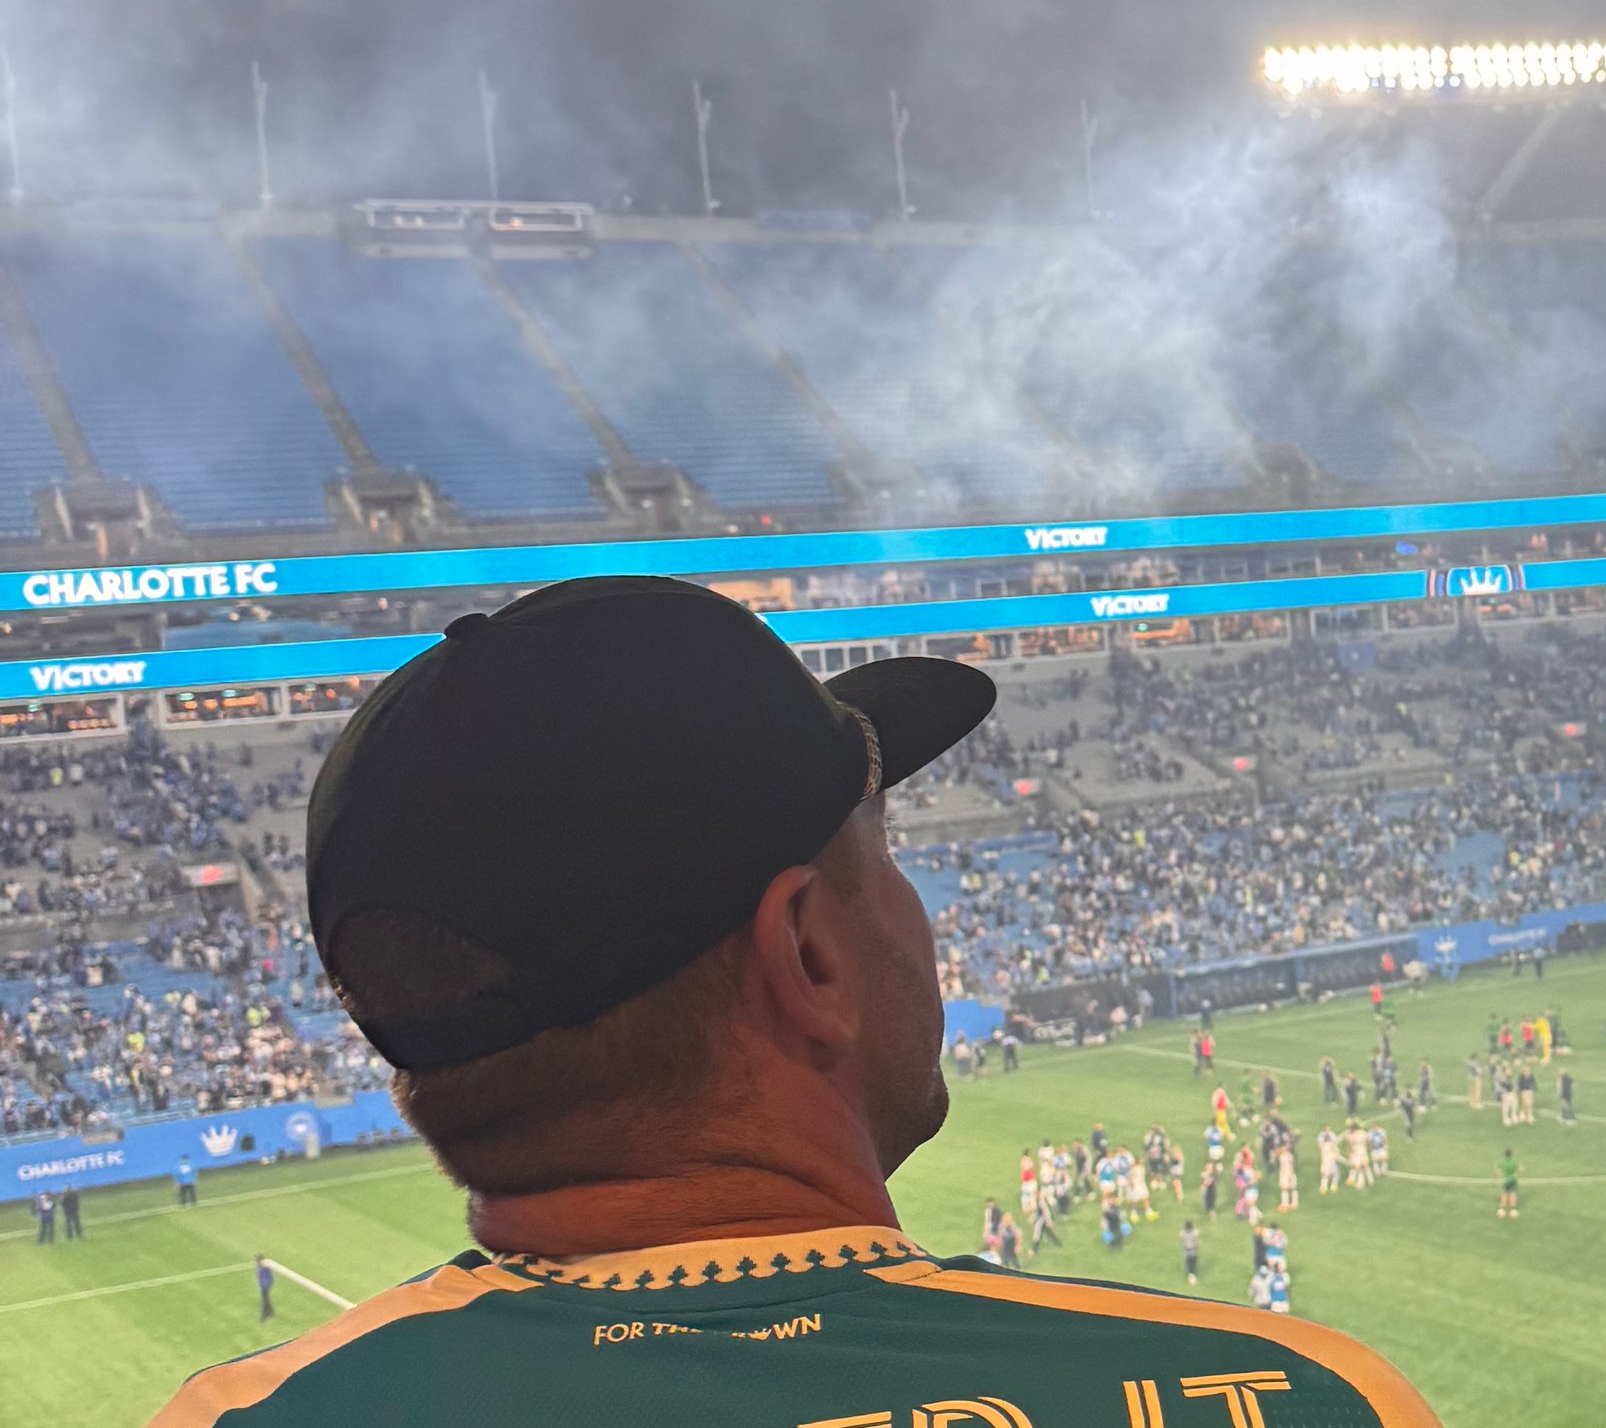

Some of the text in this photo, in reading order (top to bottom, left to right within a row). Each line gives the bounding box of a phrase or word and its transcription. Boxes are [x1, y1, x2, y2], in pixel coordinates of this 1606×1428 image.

[1024, 526, 1108, 550] VICTORY
[23, 563, 278, 605] CHARLOTTE FC
[1090, 594, 1170, 617] VICTORY
[30, 660, 147, 690] VICTORY
[17, 1149, 125, 1181] CHARLOTTE FC
[593, 1321, 645, 1346] FOR
